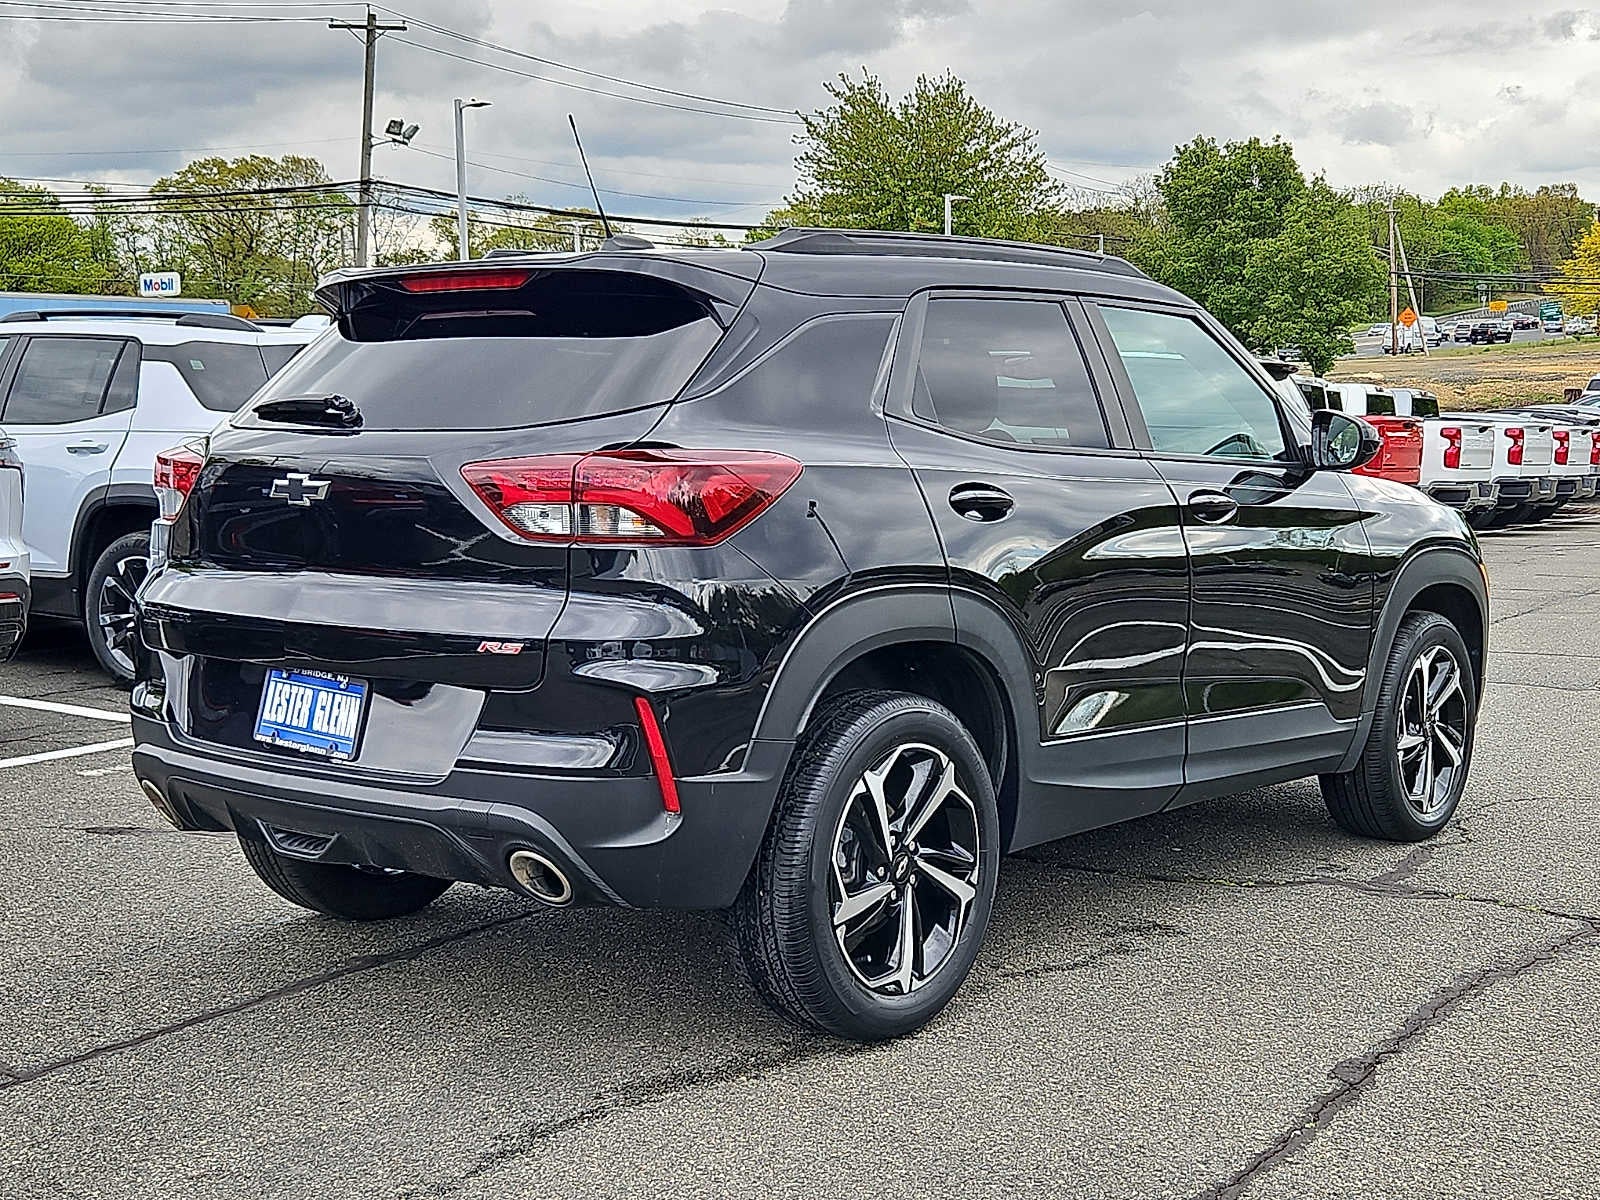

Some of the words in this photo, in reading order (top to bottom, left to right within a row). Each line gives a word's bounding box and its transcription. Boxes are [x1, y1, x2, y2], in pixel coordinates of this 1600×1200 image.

[143, 277, 174, 291] Mobil
[477, 641, 524, 654] RS
[336, 674, 349, 683] NJ
[263, 681, 314, 729] LESTER
[312, 690, 361, 739] GLENN
